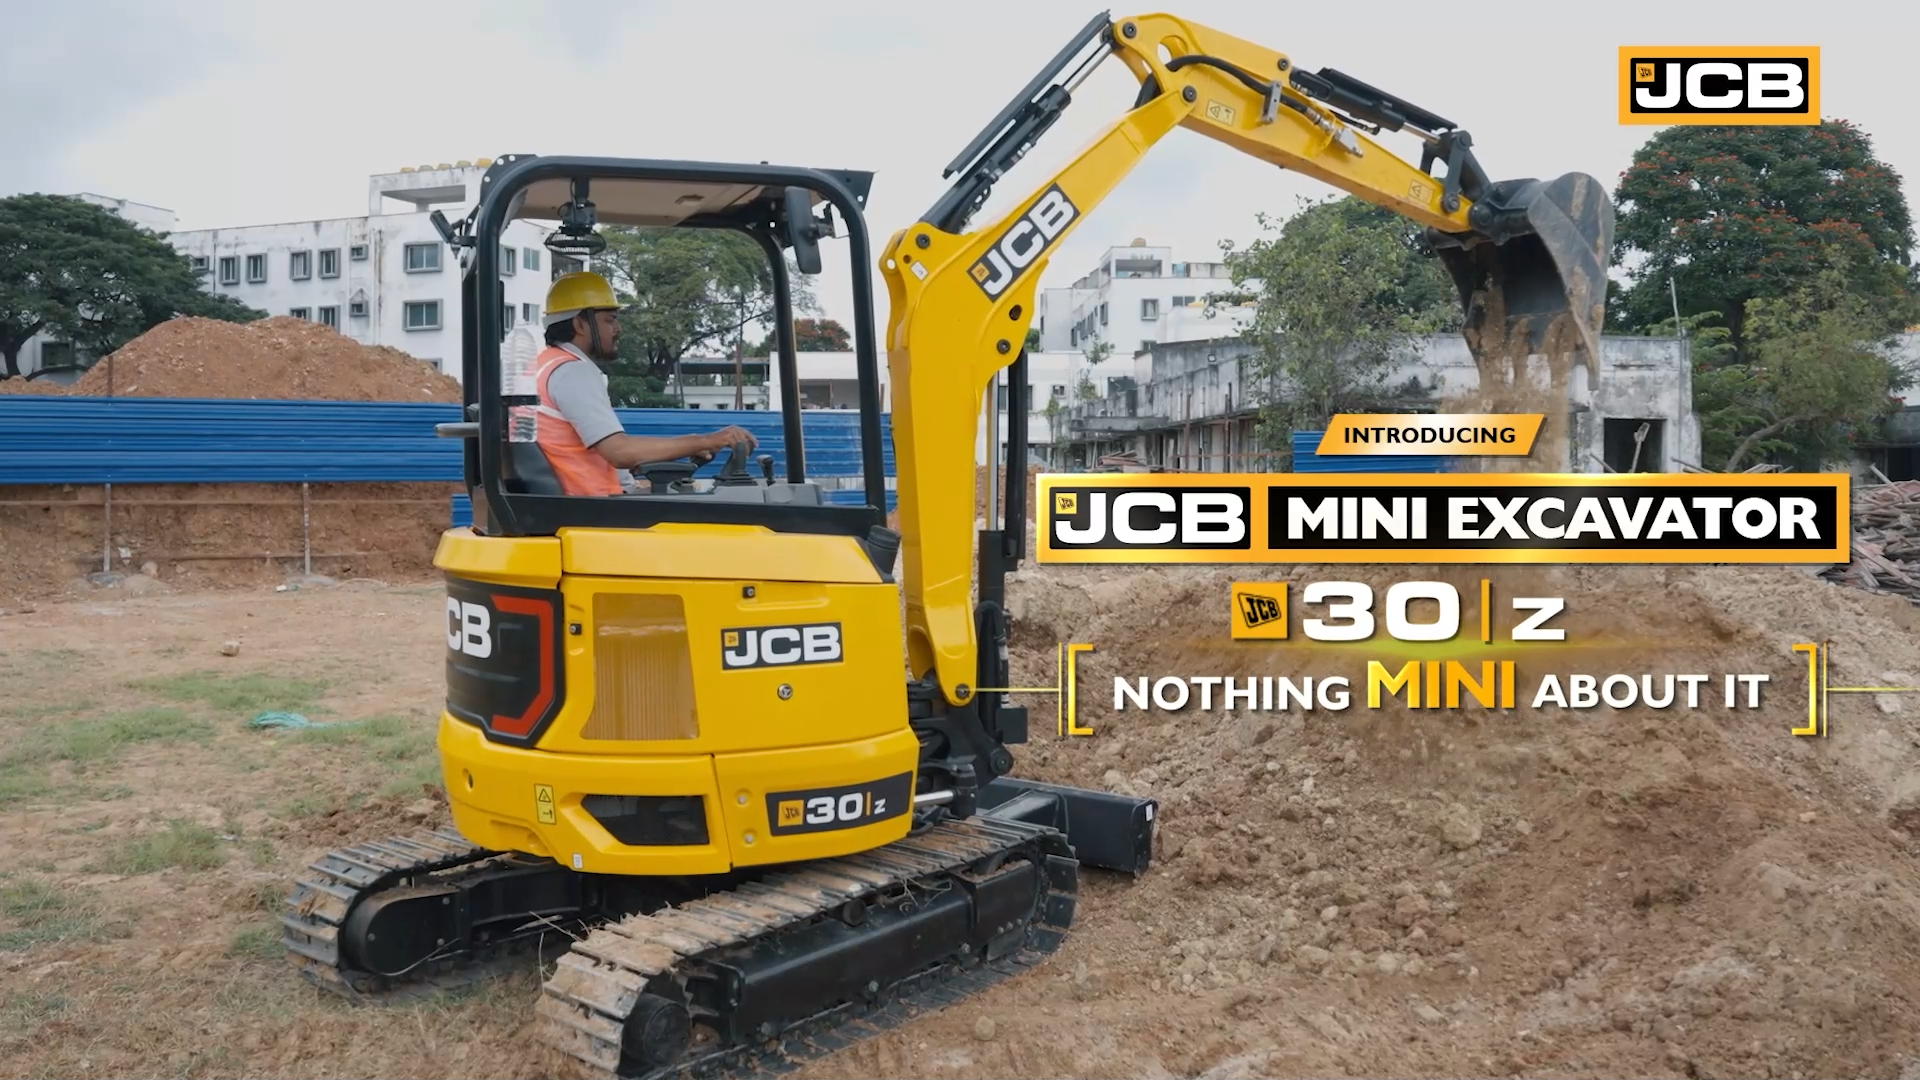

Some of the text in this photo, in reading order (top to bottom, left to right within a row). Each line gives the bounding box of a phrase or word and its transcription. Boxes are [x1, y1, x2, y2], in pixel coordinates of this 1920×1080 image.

[983, 190, 1075, 295] JCB
[725, 625, 841, 666] JCB
[806, 792, 863, 824] 30
